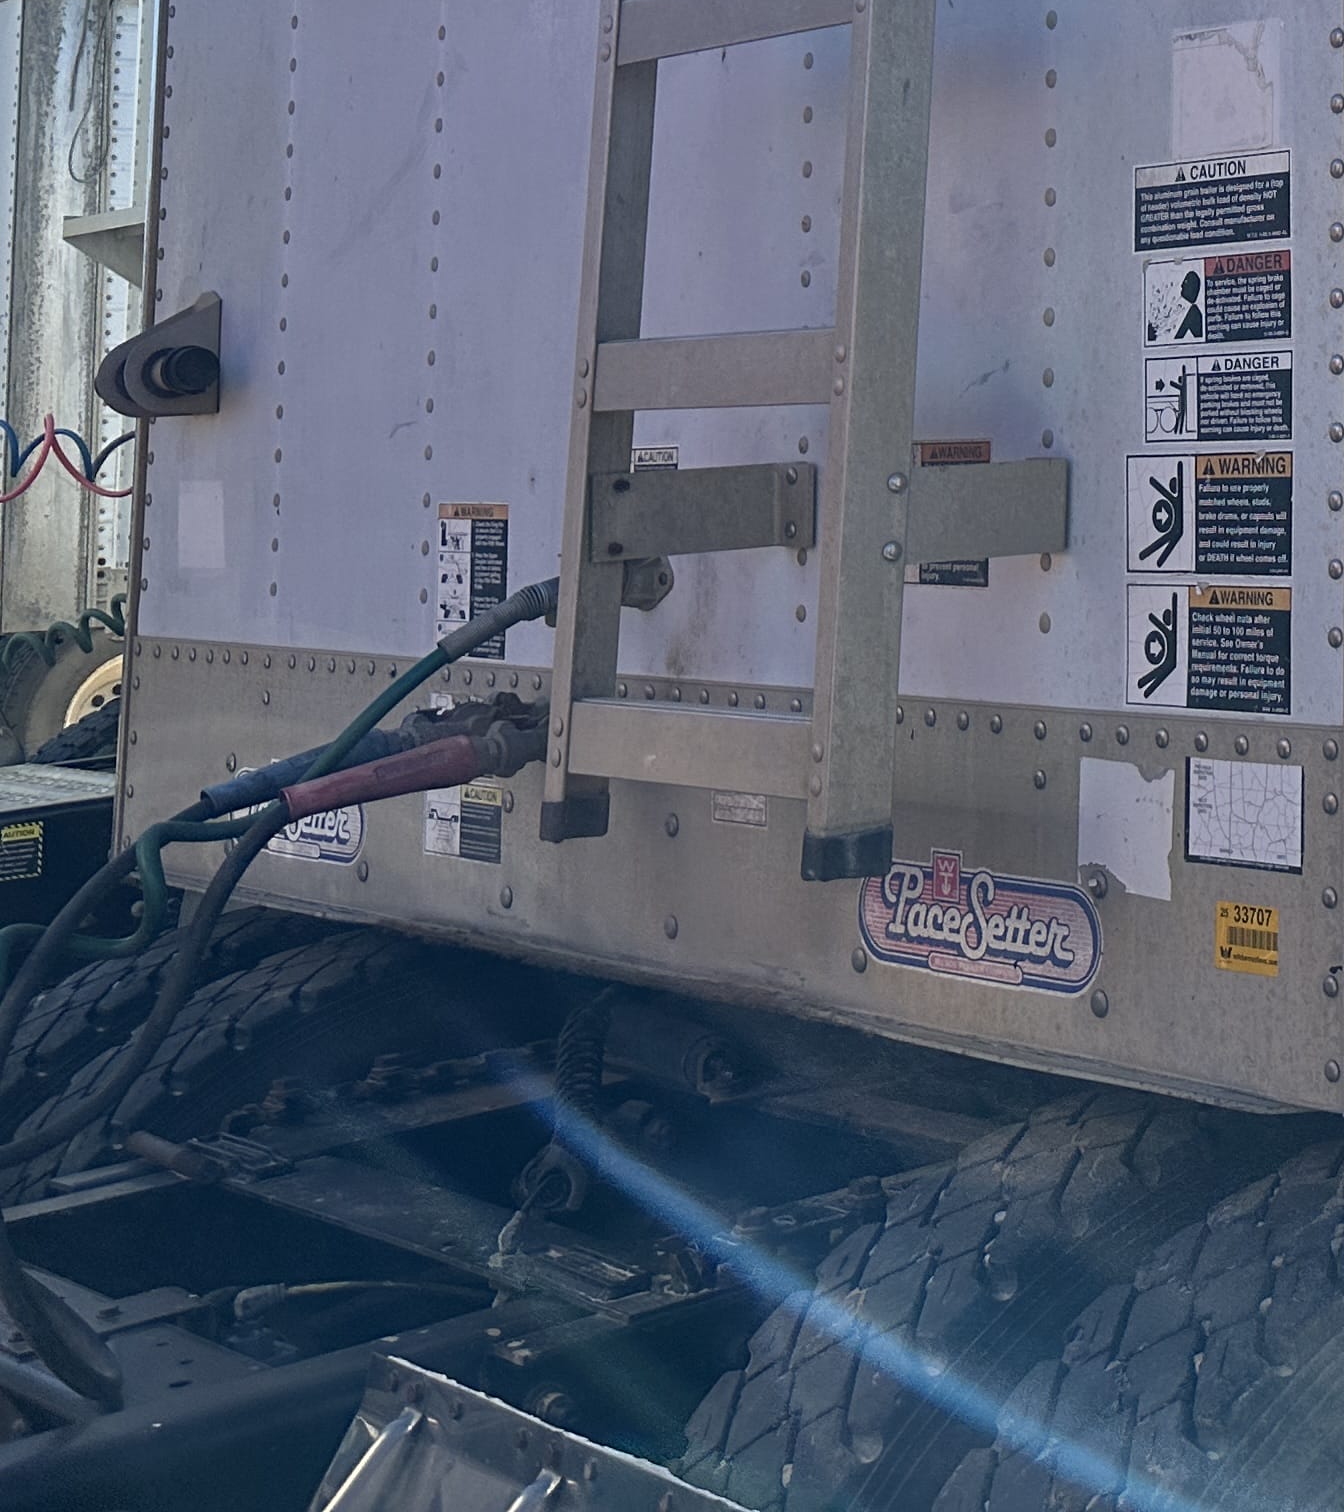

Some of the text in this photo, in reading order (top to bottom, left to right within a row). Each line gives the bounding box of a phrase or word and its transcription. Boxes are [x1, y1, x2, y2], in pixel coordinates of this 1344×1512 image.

[1190, 160, 1247, 180] CAUTION
[1226, 254, 1282, 273] DANGER
[1225, 356, 1279, 370] DANGER
[644, 451, 673, 463] CAUTION
[939, 446, 982, 459] WARNING
[1218, 456, 1286, 475] WARNING
[461, 508, 494, 517] WARNING
[1221, 590, 1273, 606] WARNING
[1192, 612, 1214, 622] Check
[1213, 626, 1221, 634] 50
[1223, 627, 1230, 635] to
[1232, 627, 1244, 636] 100
[1218, 651, 1227, 659] for
[1201, 676, 1215, 685] may
[1191, 687, 1217, 699] damage
[470, 788, 497, 801] CAUTION
[3, 829, 34, 838] AUTION
[883, 864, 1075, 963] PaceSetter
[1234, 905, 1272, 927] 33707
